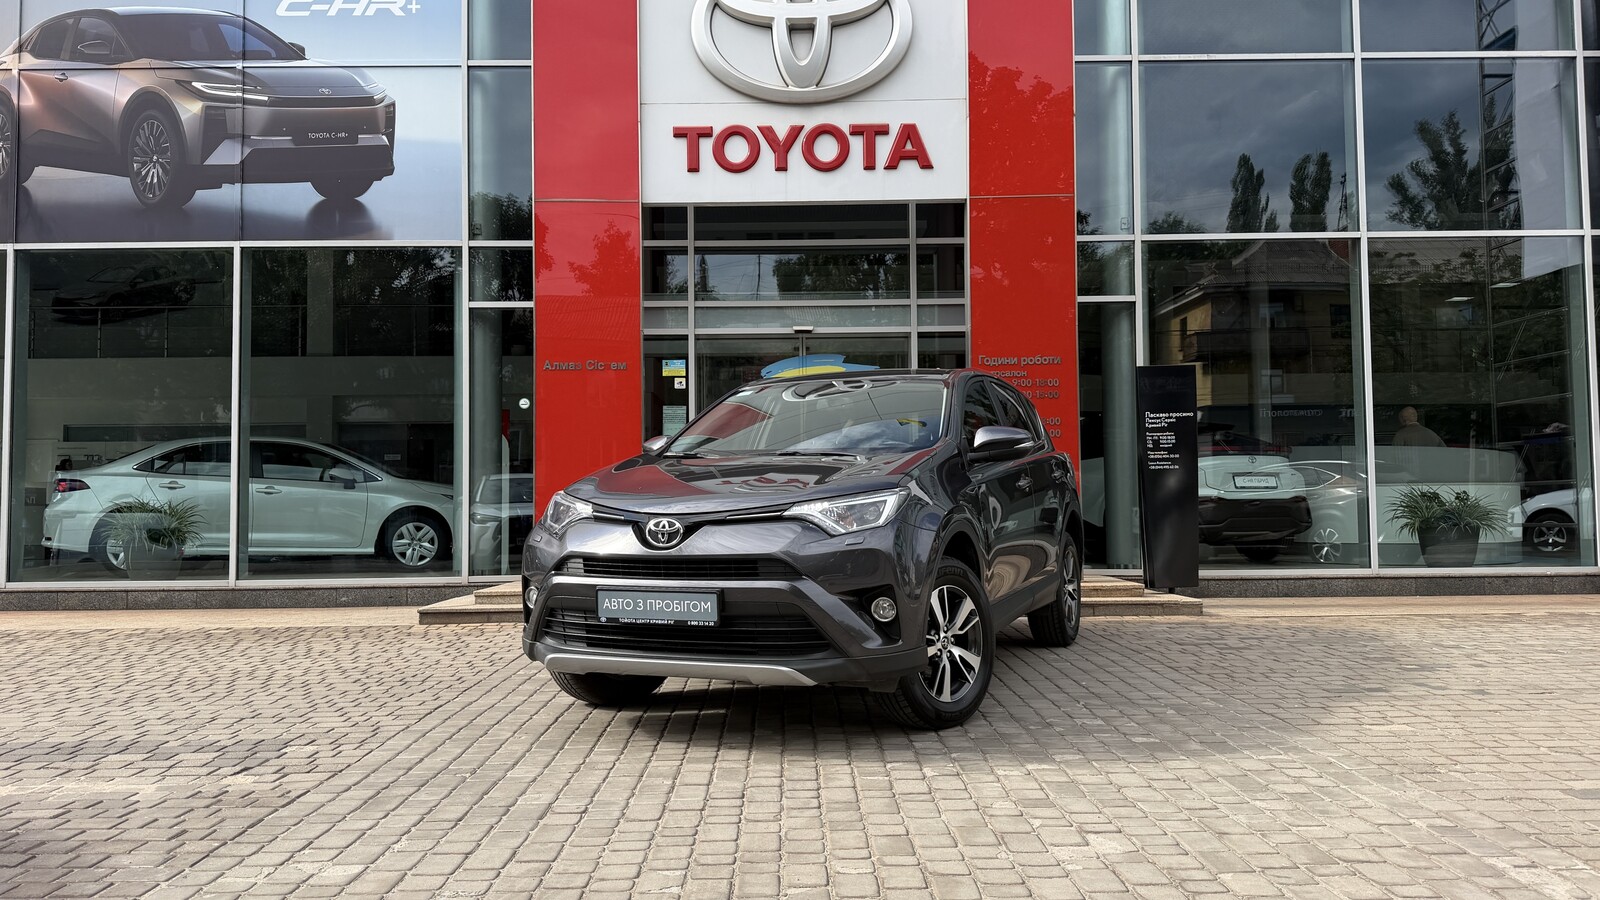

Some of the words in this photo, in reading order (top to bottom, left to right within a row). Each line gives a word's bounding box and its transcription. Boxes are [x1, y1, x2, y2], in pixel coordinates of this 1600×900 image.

[672, 122, 935, 173] TOYOTA
[543, 360, 583, 370] Алмаз
[585, 360, 627, 370] Сісем
[978, 355, 1018, 367] Години
[1020, 354, 1062, 367] роботи
[603, 598, 634, 610] АВТО
[636, 599, 644, 611] З
[647, 600, 711, 613] ПРОБІГОМ
